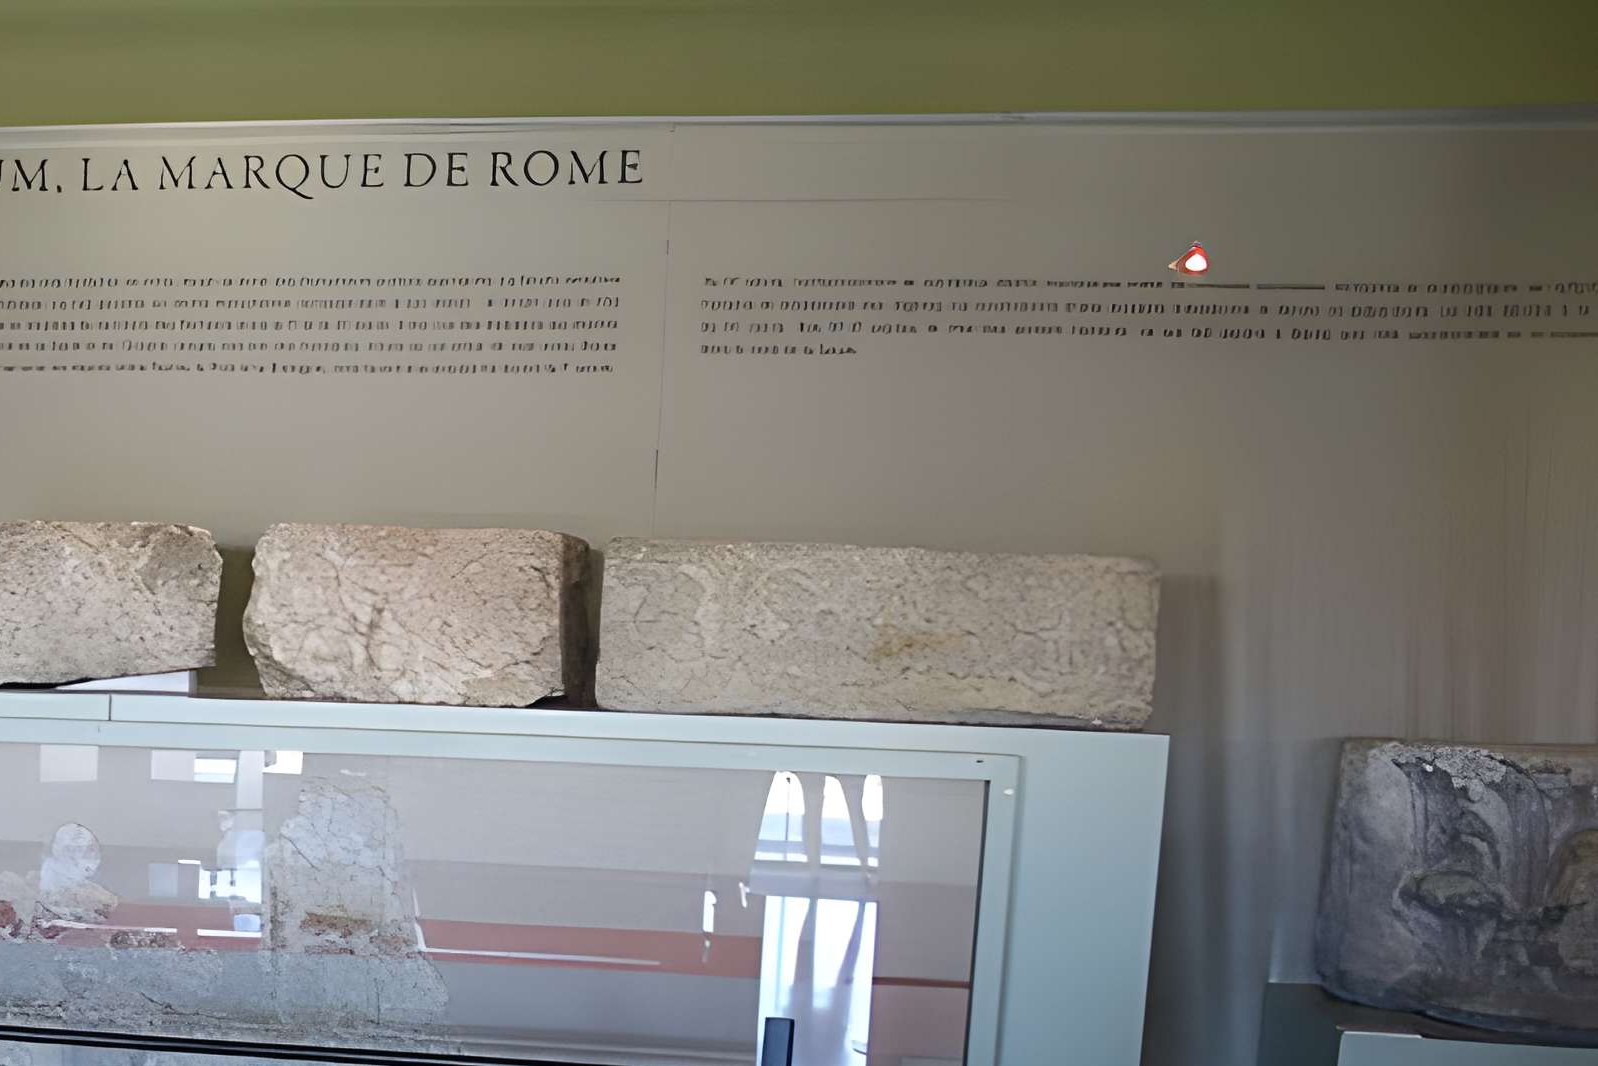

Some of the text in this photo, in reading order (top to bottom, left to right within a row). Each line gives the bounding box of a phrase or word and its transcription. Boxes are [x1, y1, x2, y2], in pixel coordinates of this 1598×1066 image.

[81, 157, 139, 192] LA
[158, 153, 385, 200] MARQUE
[402, 151, 470, 188] DE
[489, 149, 643, 187] ROME
